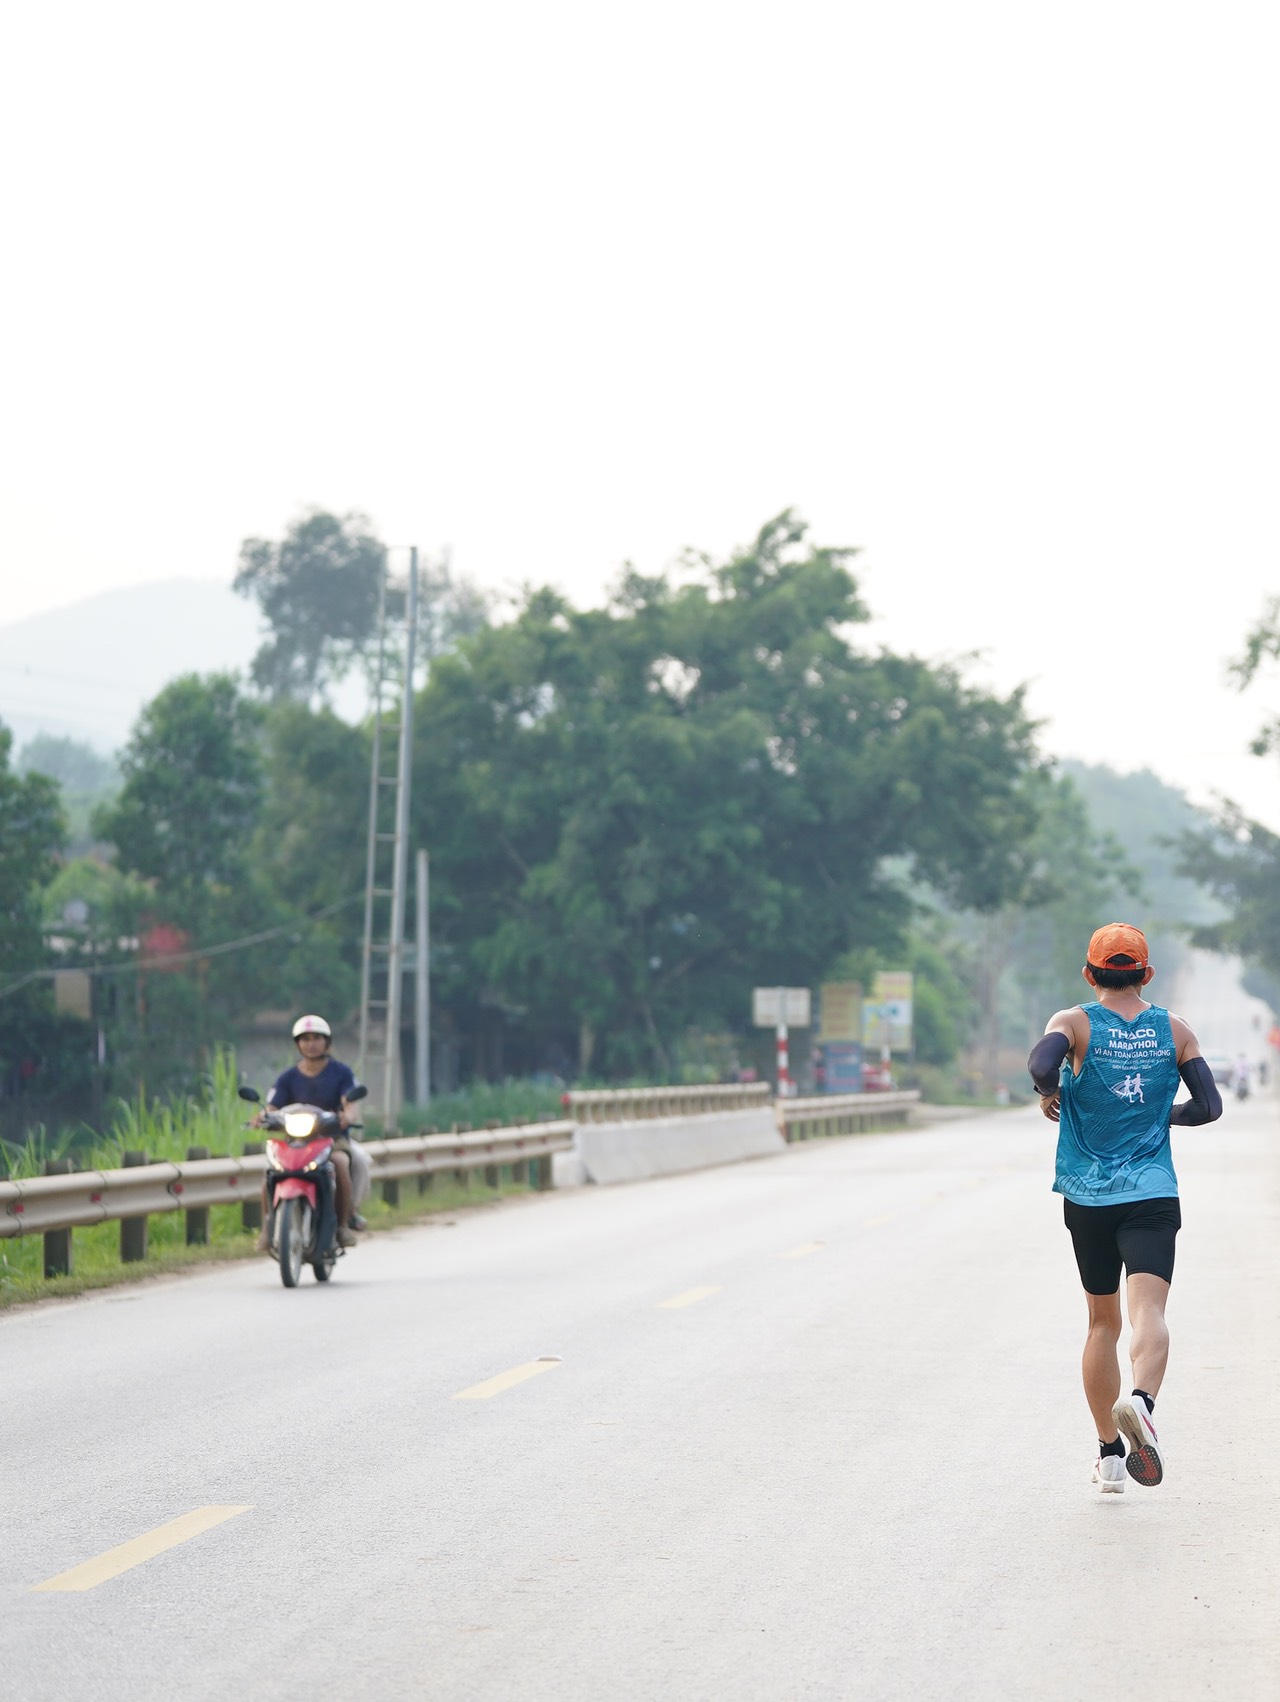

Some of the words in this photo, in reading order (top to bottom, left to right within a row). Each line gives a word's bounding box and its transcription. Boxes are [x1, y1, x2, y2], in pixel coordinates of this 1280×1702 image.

[1108, 1028, 1156, 1040] THACO
[1109, 1040, 1158, 1050] MARATHON
[1102, 1049, 1112, 1057] AN
[1131, 1050, 1148, 1059] GIAO
